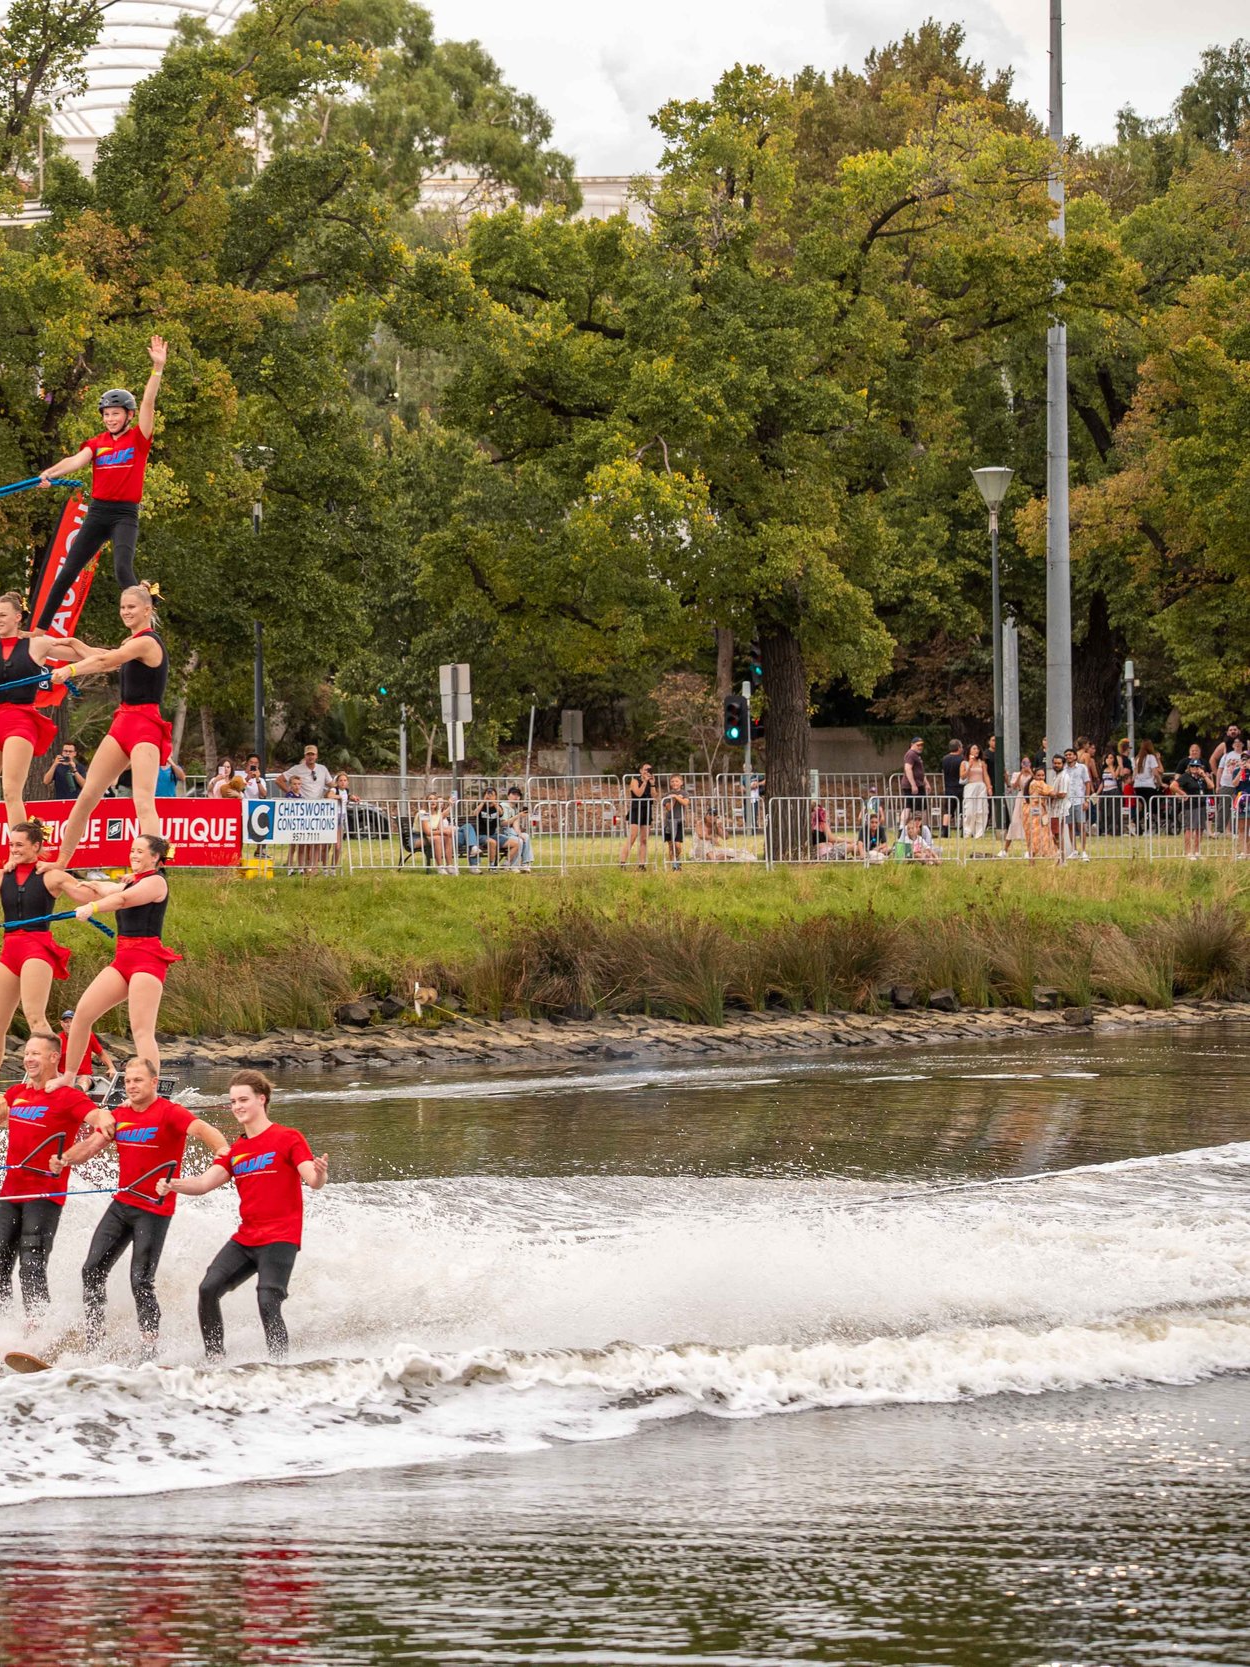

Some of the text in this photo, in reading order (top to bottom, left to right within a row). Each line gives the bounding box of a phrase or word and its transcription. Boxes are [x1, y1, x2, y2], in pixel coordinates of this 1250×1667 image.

[278, 802, 336, 816] CHATSWORTH
[124, 817, 238, 843] NUTIQUE
[277, 818, 335, 831] CONSTRUCTIONS
